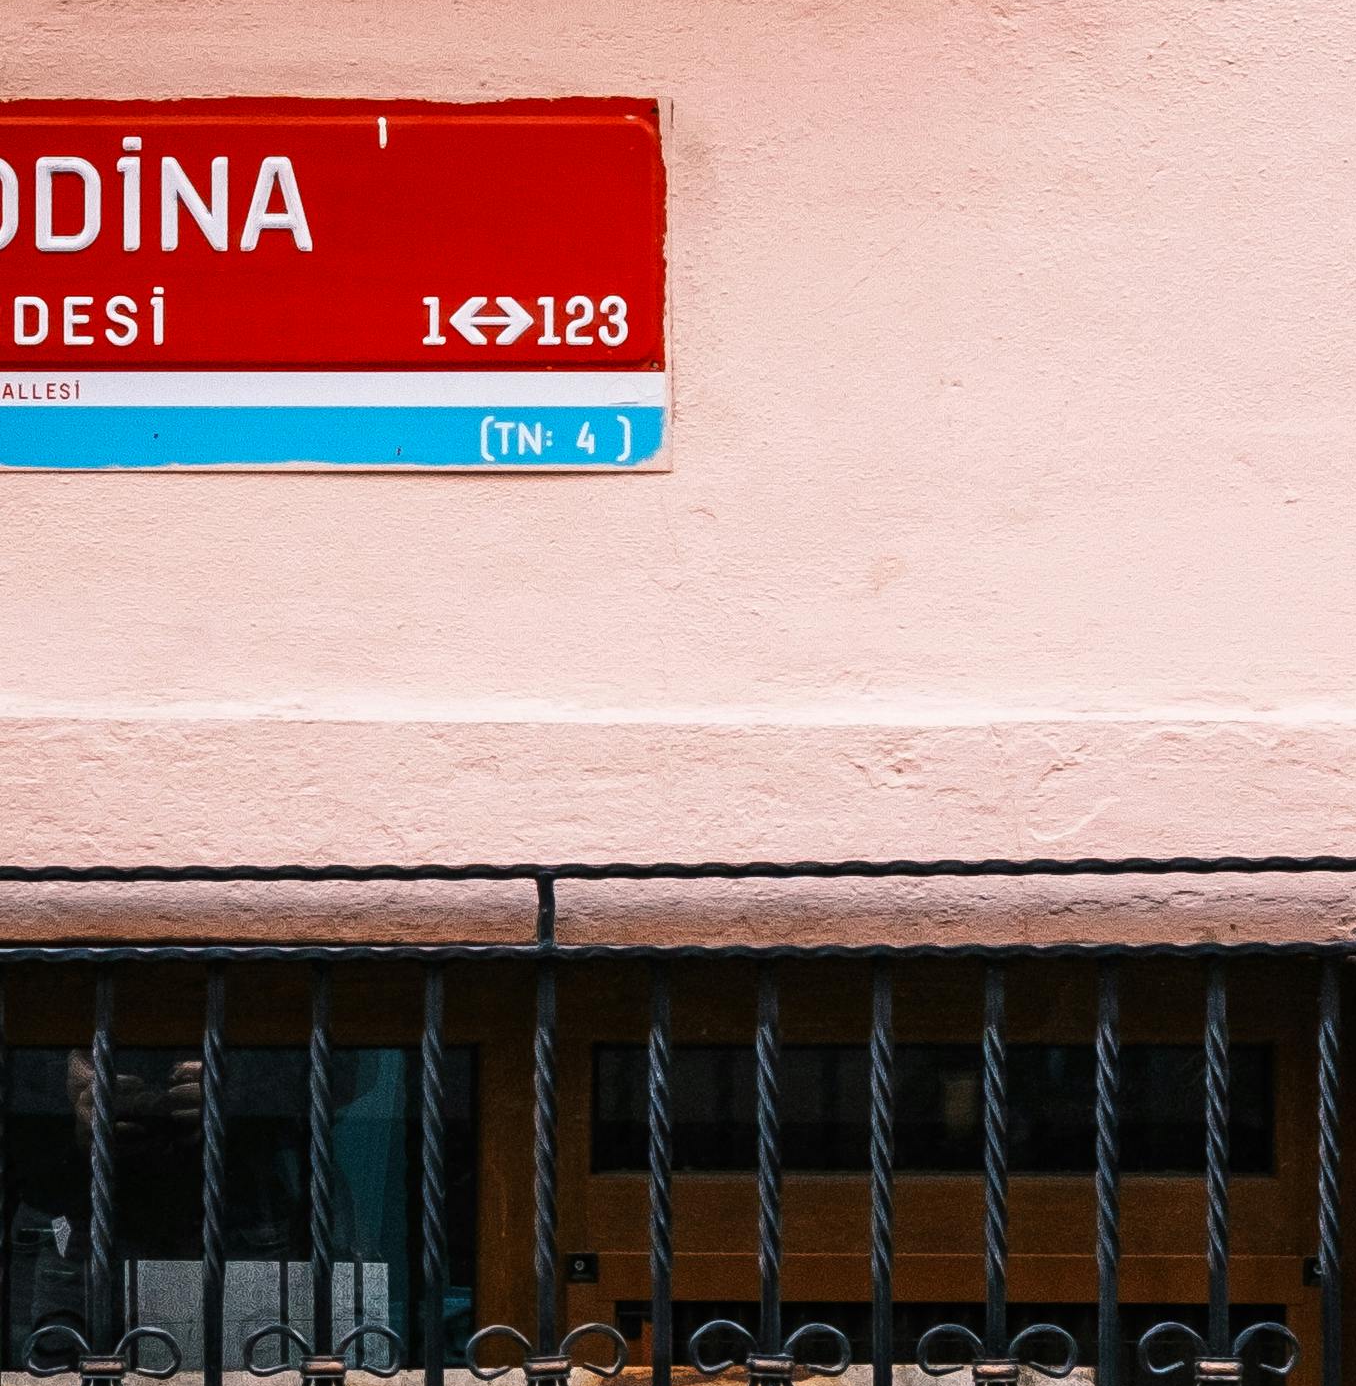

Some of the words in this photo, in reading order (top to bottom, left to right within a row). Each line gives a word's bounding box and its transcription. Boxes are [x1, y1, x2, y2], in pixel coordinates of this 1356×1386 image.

[0, 136, 313, 252] DİNA
[13, 286, 165, 347] DESİ
[536, 294, 629, 347] 123
[1, 379, 81, 401] ALLESİ
